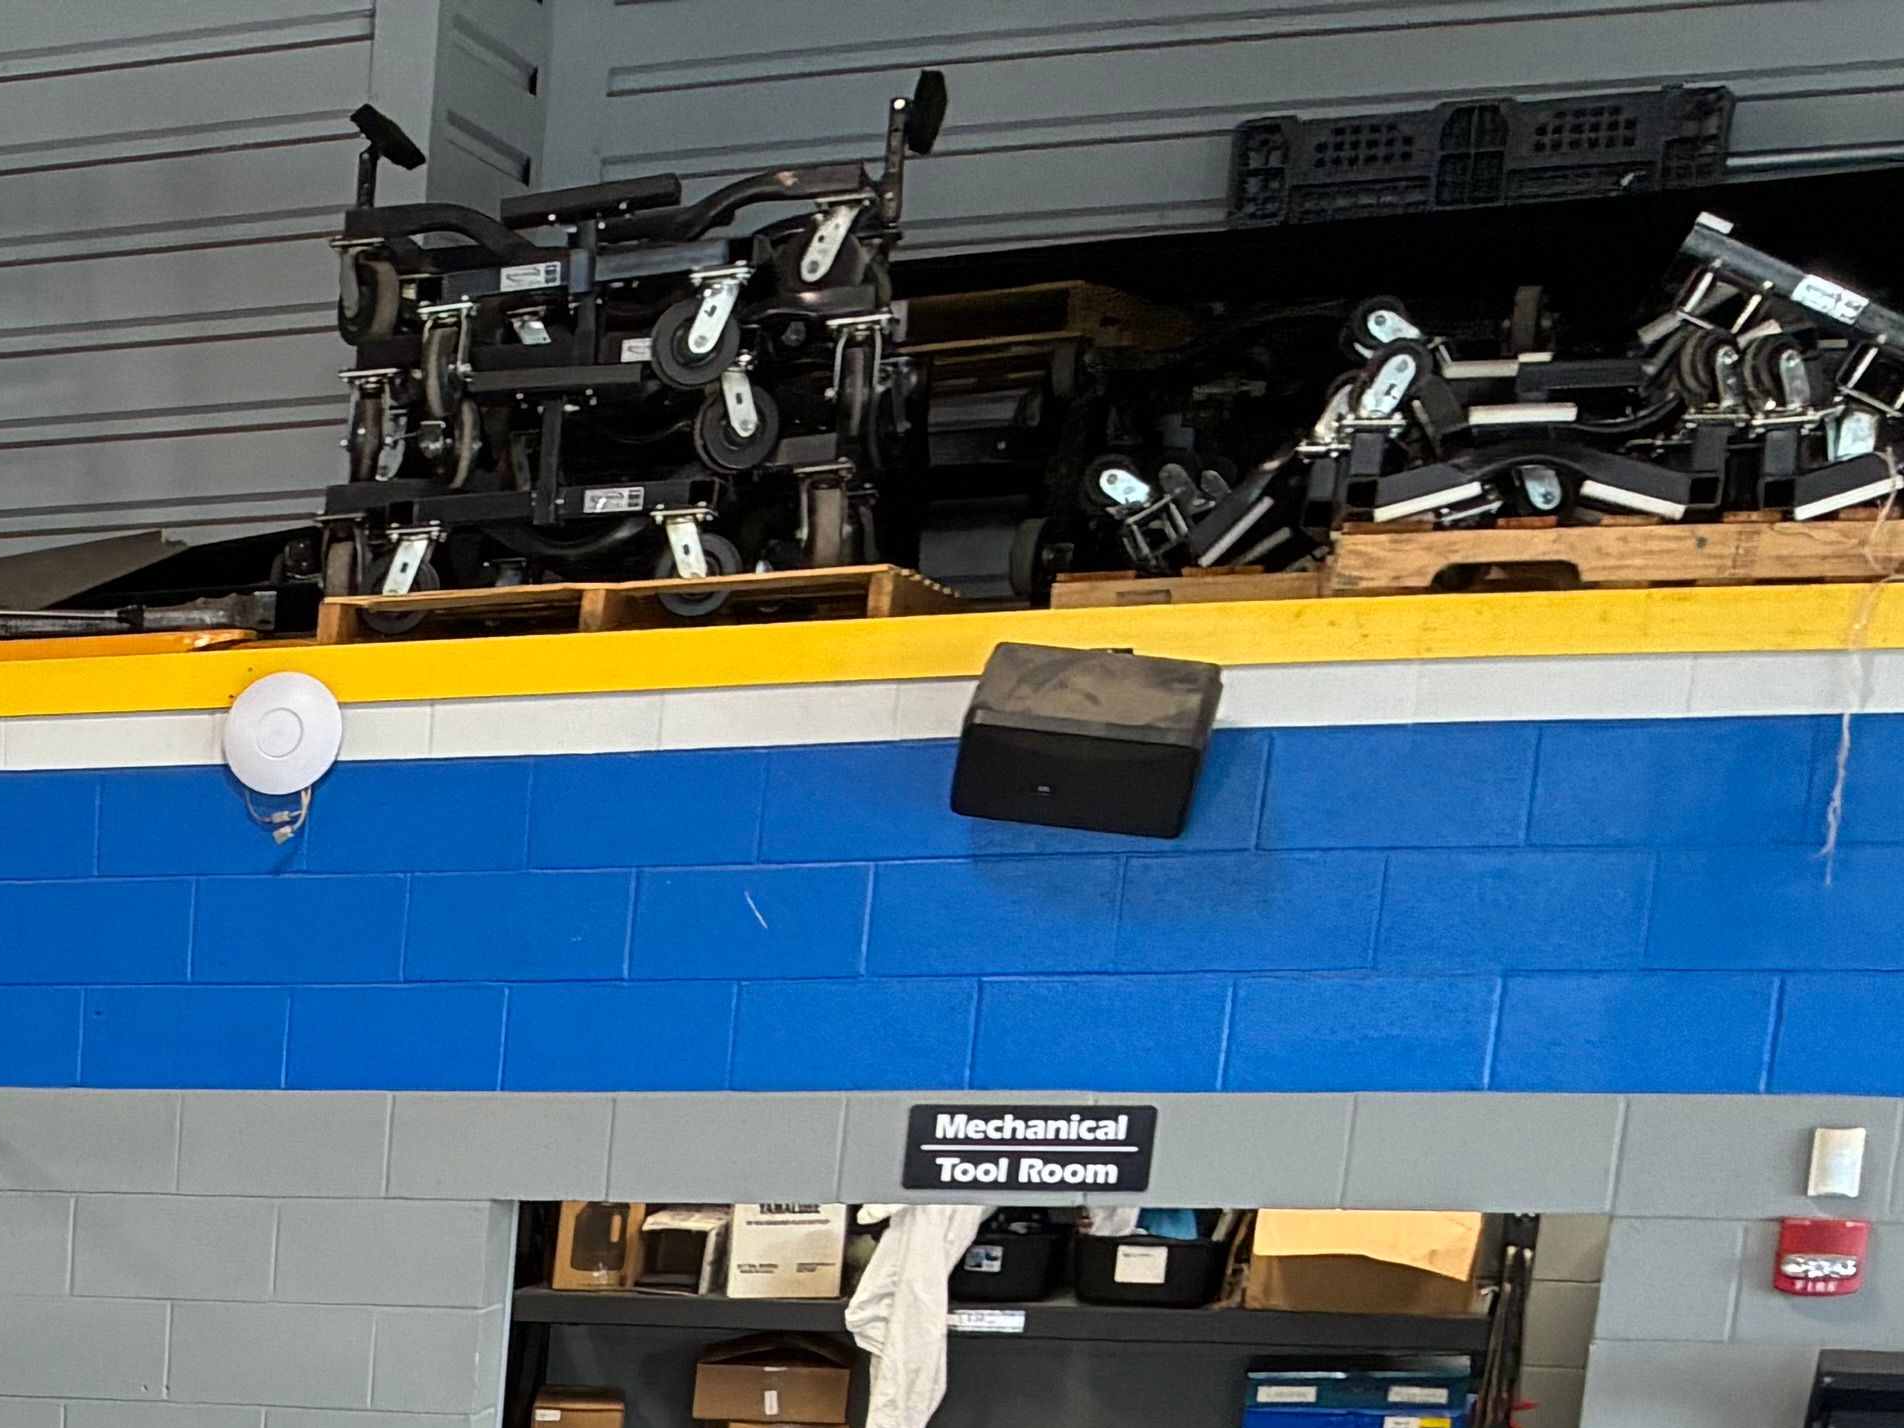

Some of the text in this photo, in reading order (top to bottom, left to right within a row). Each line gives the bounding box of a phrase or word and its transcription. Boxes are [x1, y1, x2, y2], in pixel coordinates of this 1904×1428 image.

[935, 1114, 1128, 1140] Mechanical
[935, 1157, 1118, 1184] Tool Room
